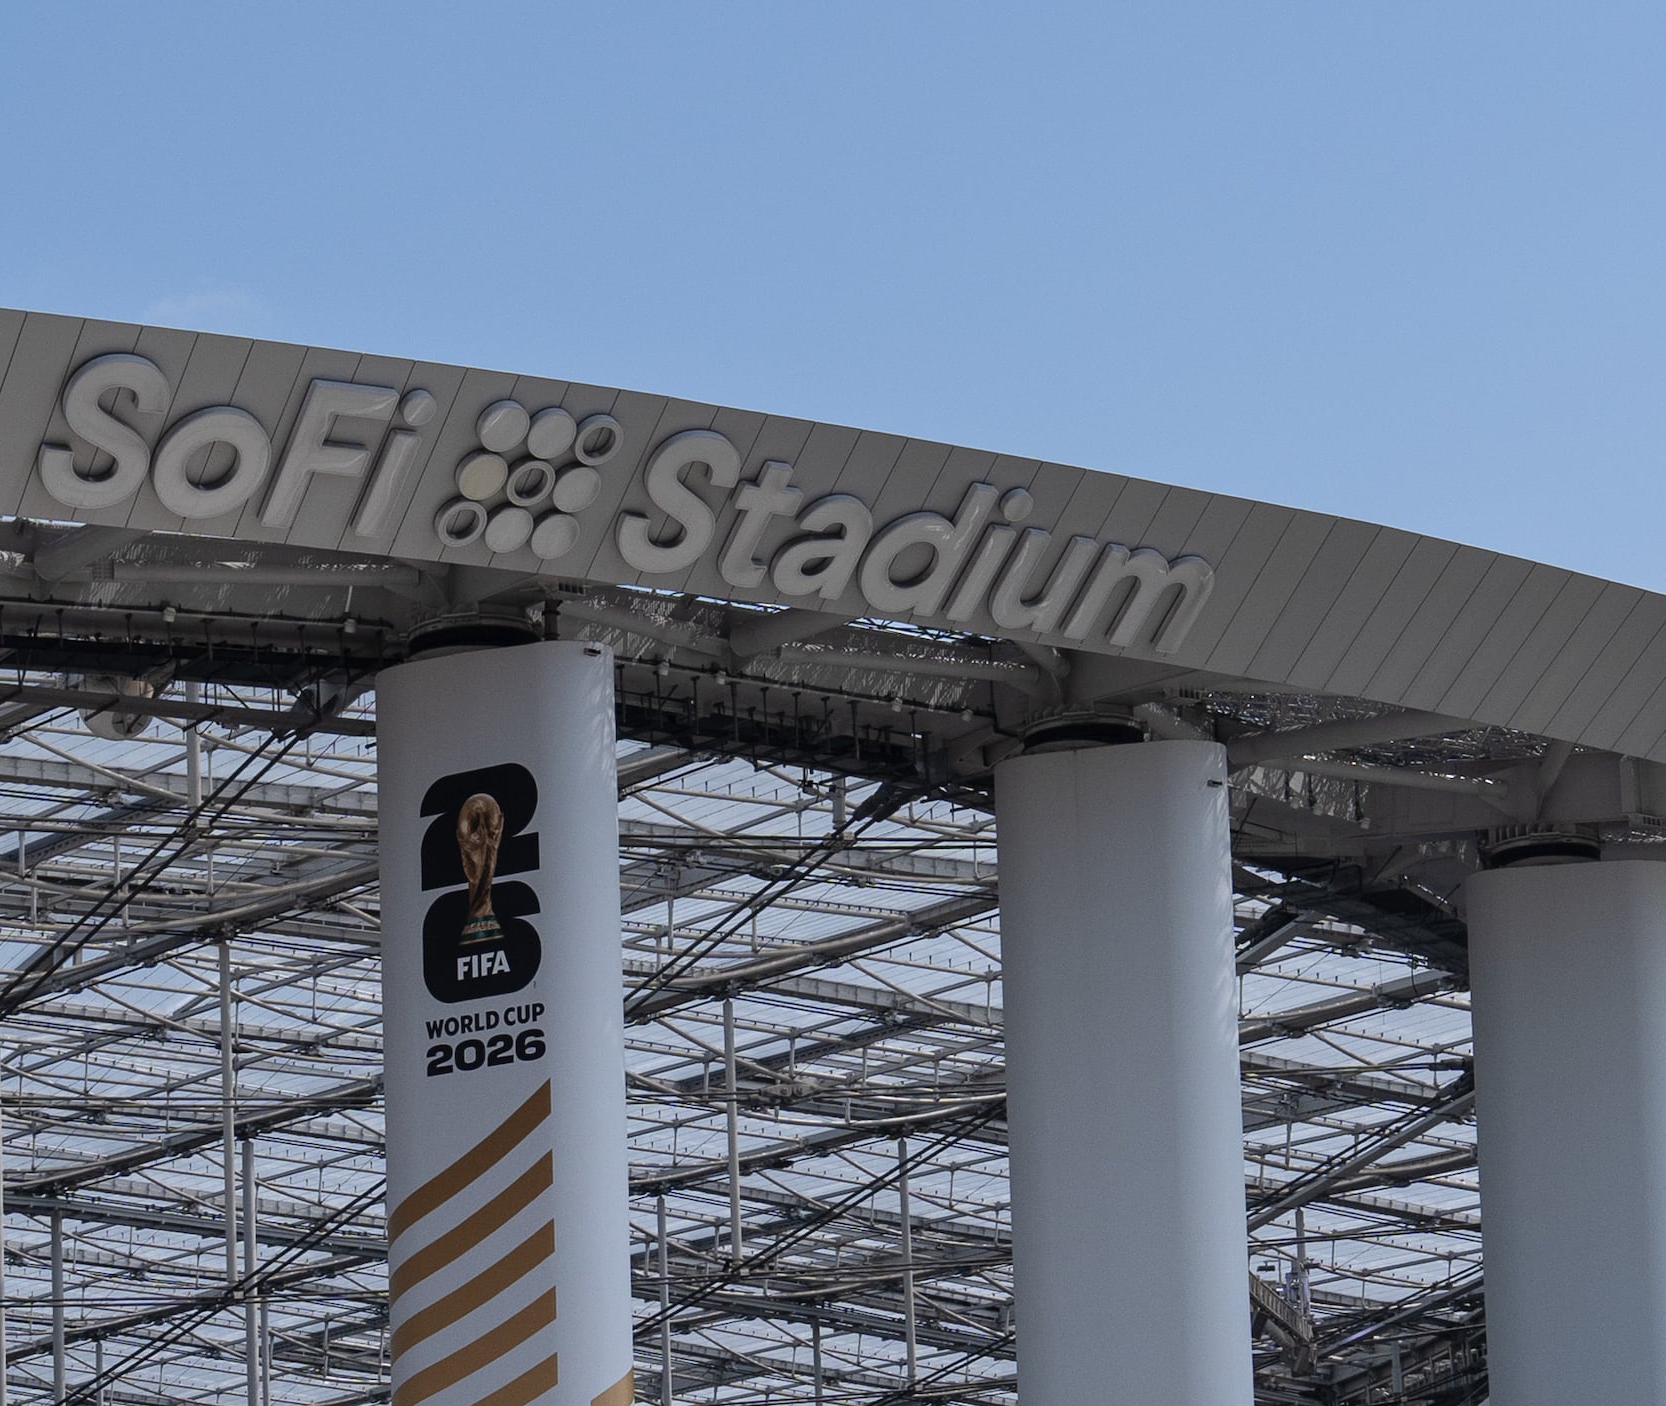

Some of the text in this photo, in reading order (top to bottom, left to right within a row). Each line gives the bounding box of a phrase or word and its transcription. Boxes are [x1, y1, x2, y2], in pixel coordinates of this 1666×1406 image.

[38, 353, 1214, 653] SoFi Stadium
[457, 950, 511, 981] FIFA
[425, 1003, 545, 1039] WORLD CUP
[426, 1029, 546, 1077] 2026
